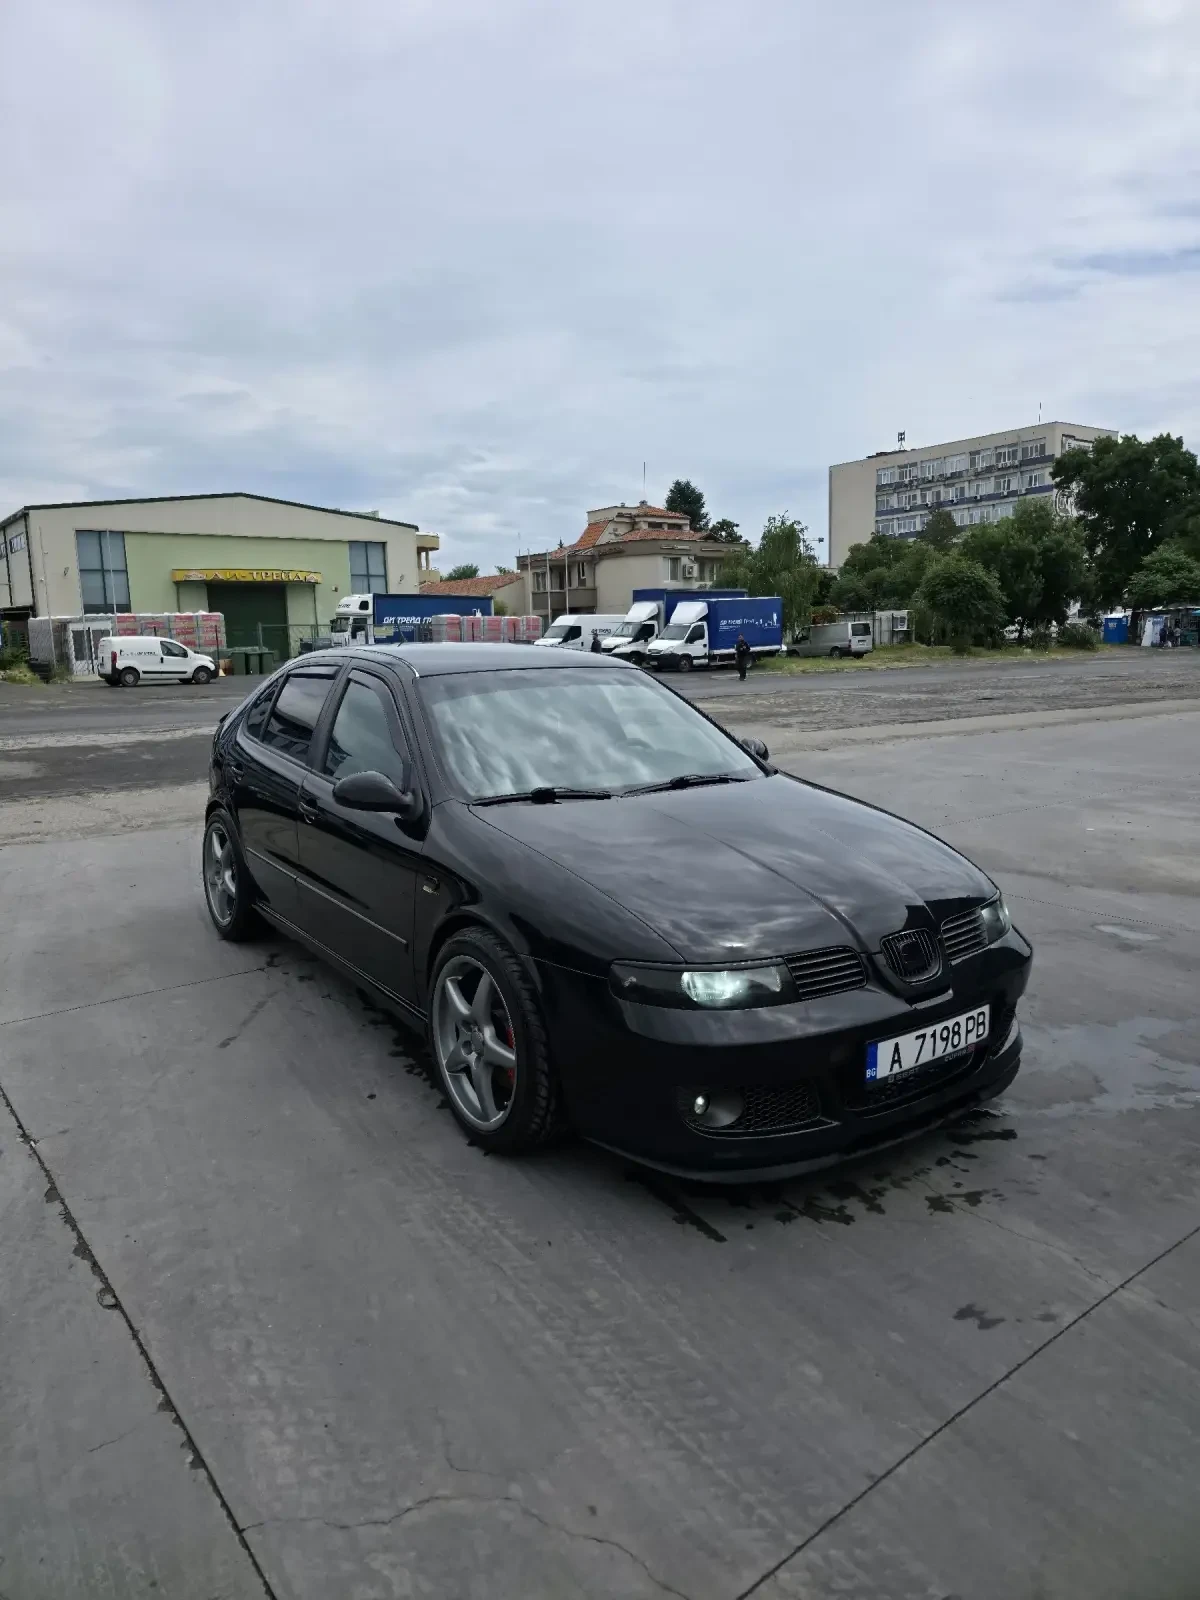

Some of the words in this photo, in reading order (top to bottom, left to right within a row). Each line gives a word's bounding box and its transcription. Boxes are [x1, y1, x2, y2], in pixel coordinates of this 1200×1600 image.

[889, 1041, 903, 1072] A
[914, 1021, 962, 1064] 7198
[965, 1011, 986, 1045] PB
[866, 1068, 876, 1078] BG
